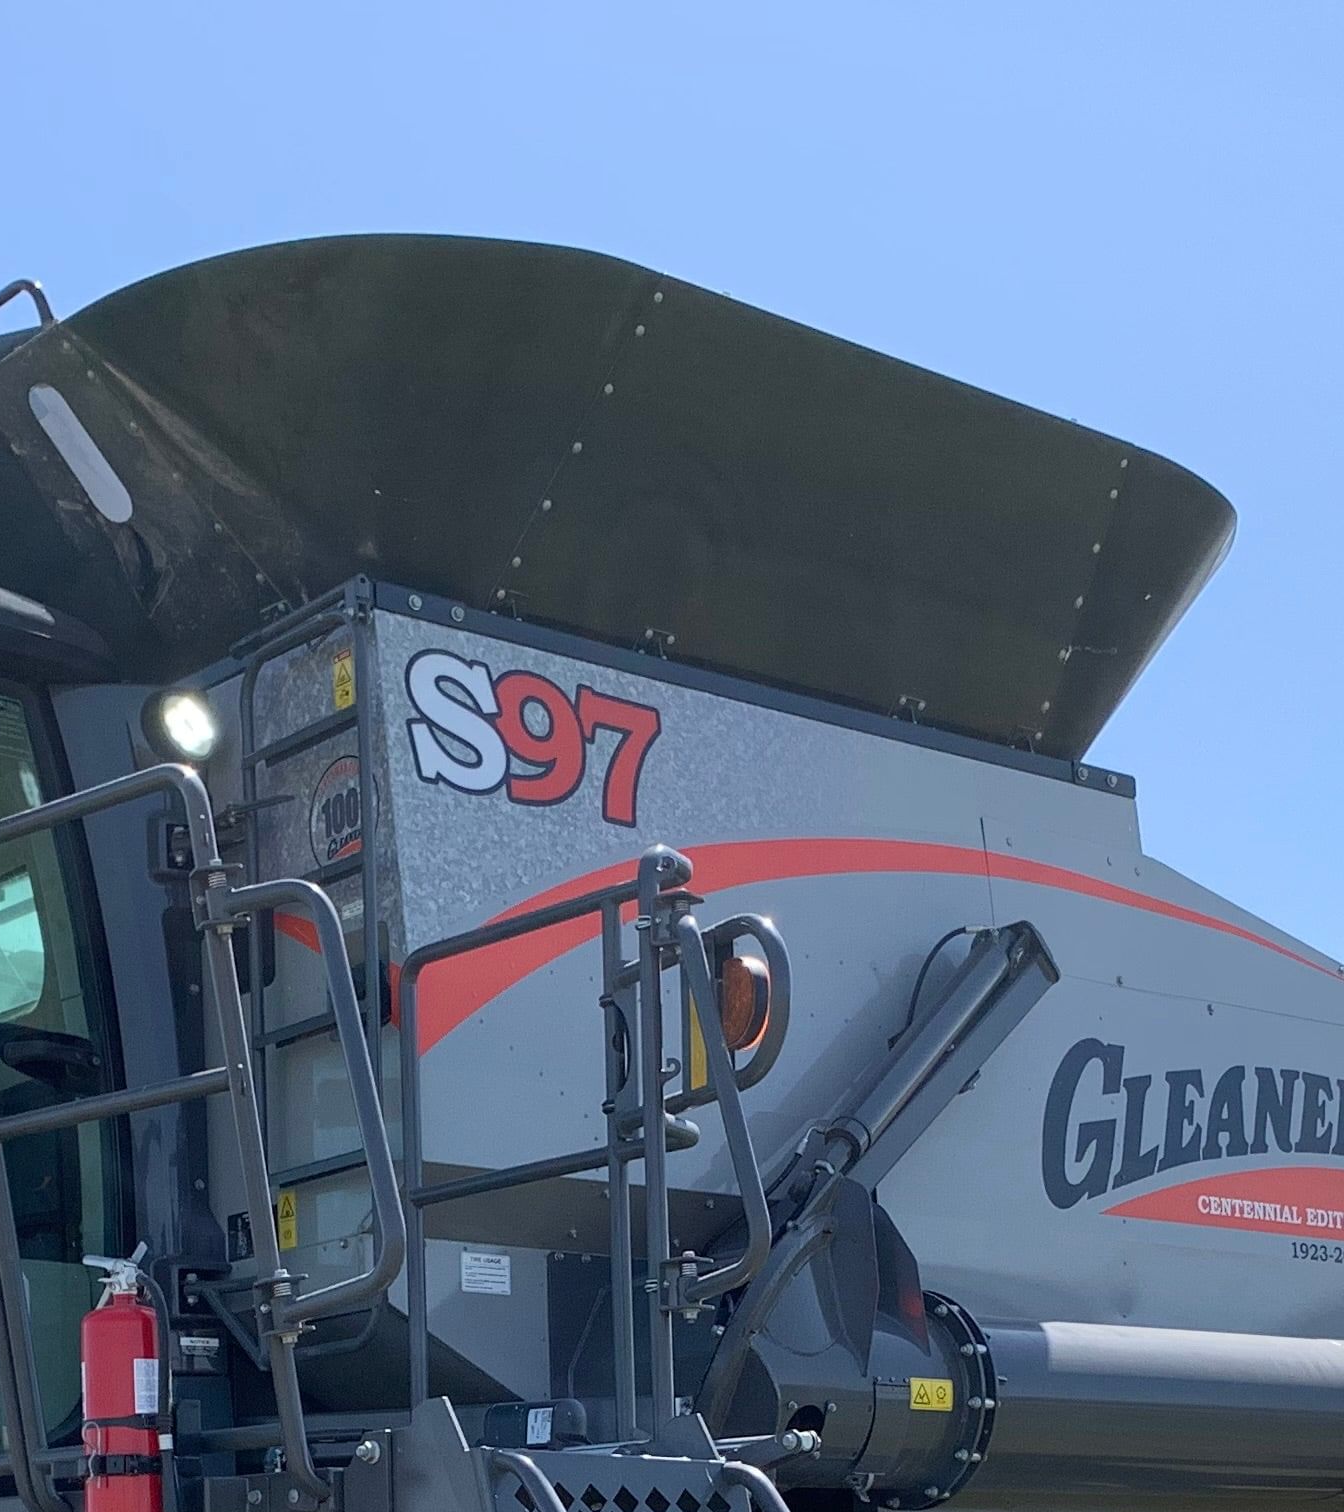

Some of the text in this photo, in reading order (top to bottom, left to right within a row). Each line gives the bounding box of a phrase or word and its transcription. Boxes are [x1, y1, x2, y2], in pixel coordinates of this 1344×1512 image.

[405, 648, 661, 828] S97
[321, 787, 359, 839] 100
[1197, 1195, 1303, 1225] CENTENNIAL
